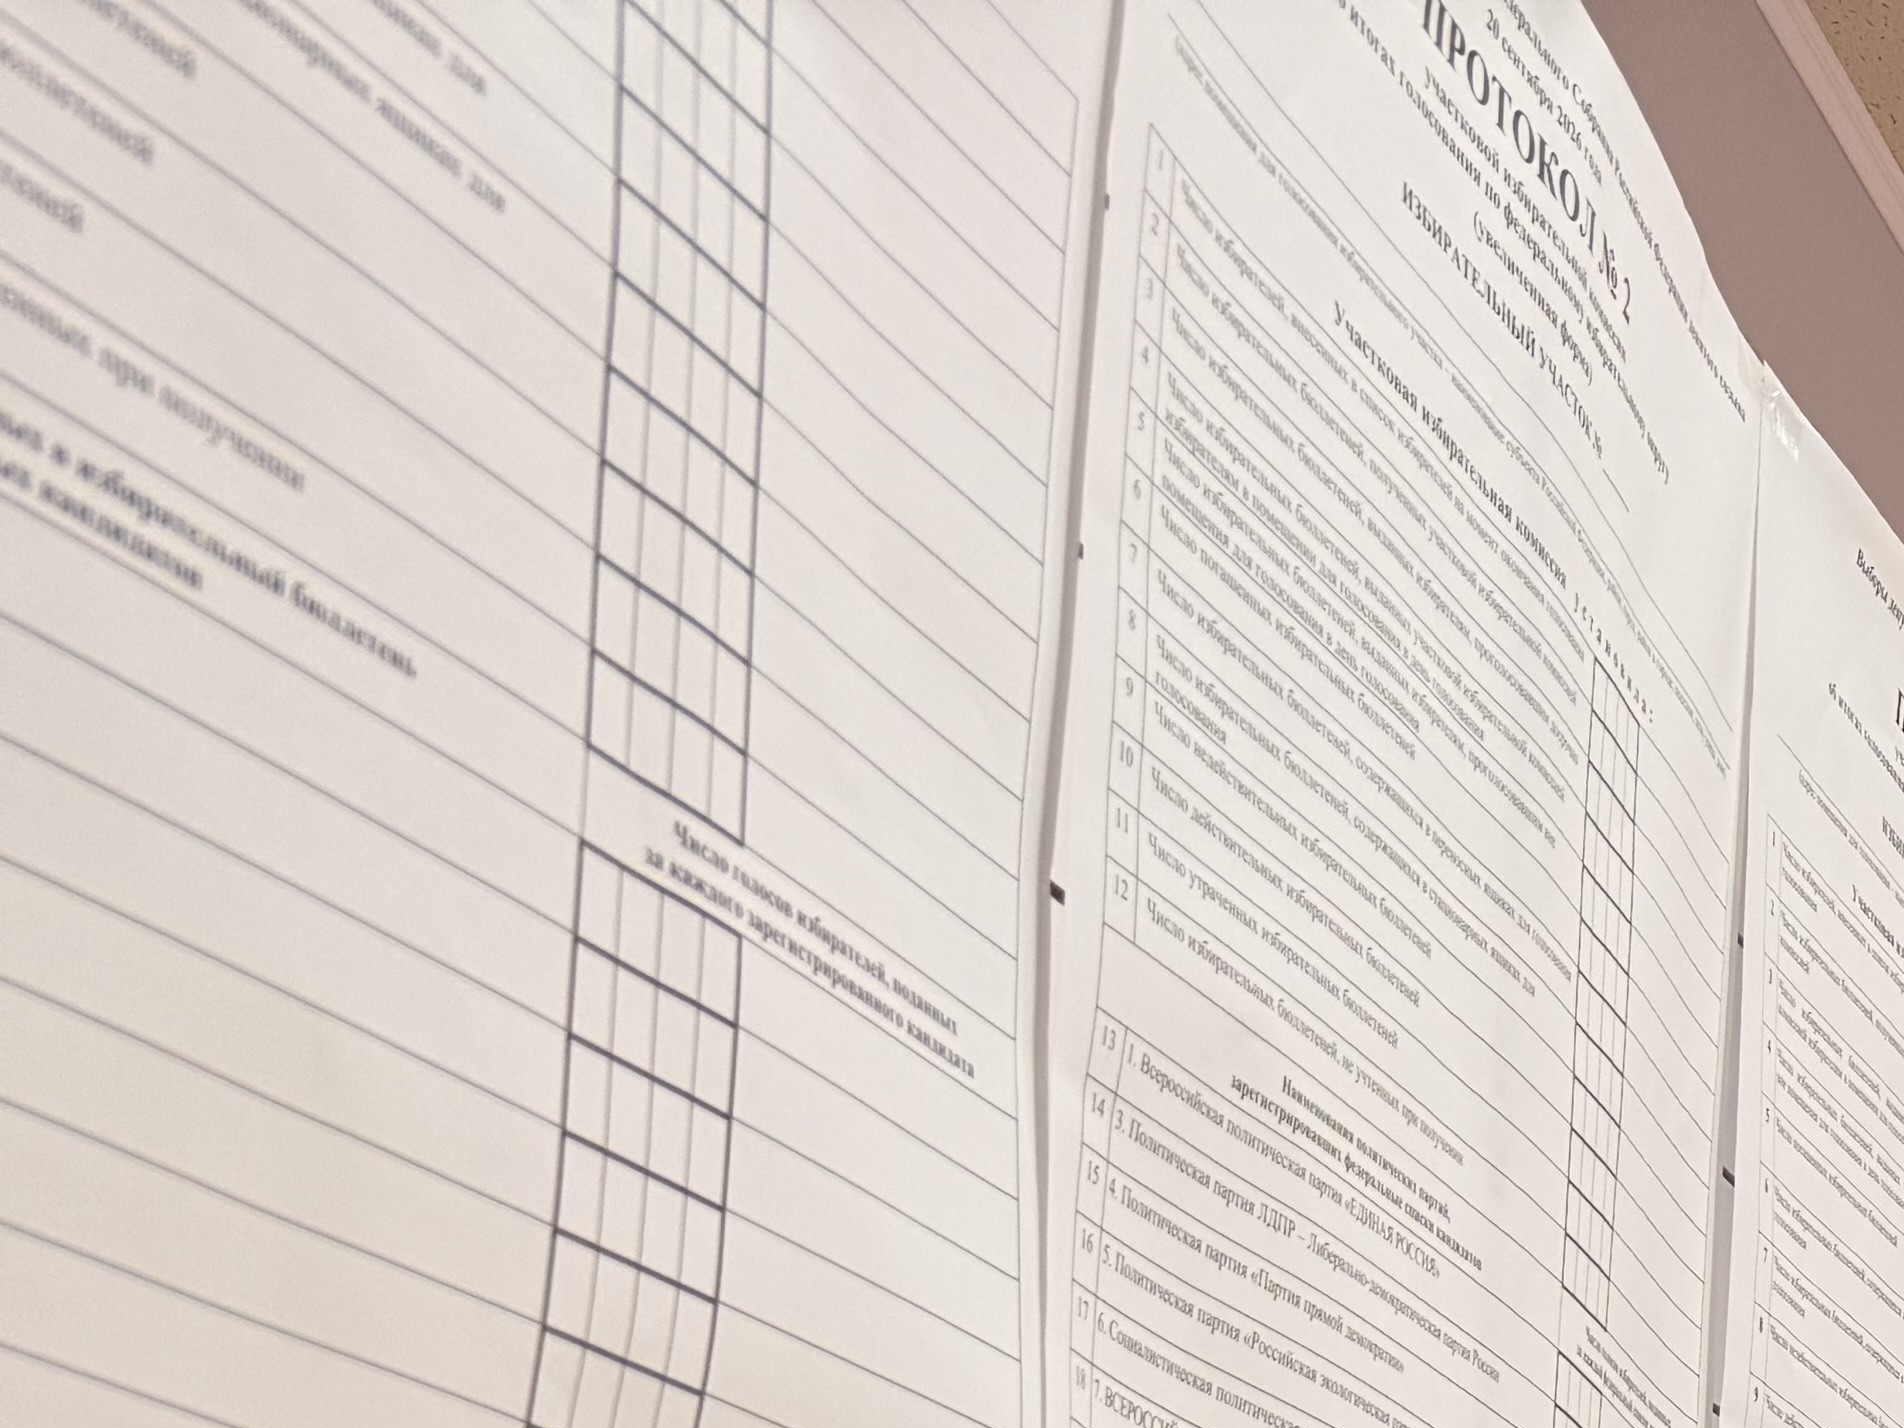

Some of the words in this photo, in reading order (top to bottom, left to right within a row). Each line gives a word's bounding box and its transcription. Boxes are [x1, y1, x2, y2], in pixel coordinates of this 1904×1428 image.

[1421, 0, 1596, 254] ПРОТОКОЛ
[1599, 231, 1618, 299] №
[1622, 277, 1631, 325] 2
[1424, 66, 1500, 173] участковой
[1503, 164, 1588, 291] избирательной
[1502, 34, 1554, 115] сентября
[1556, 105, 1582, 148] 2026
[1401, 182, 1536, 359] ИЗБИРАТЕЛЬНЫЙ
[1538, 348, 1592, 441] УЧАСТОК
[1334, 300, 1419, 413] Участковая
[1421, 404, 1513, 522] избирательная
[1515, 515, 1568, 590] комиссия
[645, 846, 664, 870] за
[670, 862, 744, 920] каждого
[748, 908, 903, 1028] зарегистрированного
[907, 1016, 975, 1078] кандидата
[674, 820, 729, 874] Число
[733, 866, 794, 919] голосов
[893, 980, 958, 1036] поданных
[1091, 1091, 1106, 1118] 14
[1101, 1025, 1117, 1051] 13
[1127, 1043, 1137, 1068] 1.
[1141, 1052, 1225, 1129] Всероссийская
[1226, 1119, 1307, 1181] политическая
[1308, 1168, 1344, 1209] партия
[1344, 1196, 1394, 1242] «ЕДИНАЯ
[1128, 1117, 1211, 1190] Политическая
[1213, 1180, 1256, 1217] партия
[1257, 1202, 1296, 1239] ЛДПР
[1121, 1183, 1202, 1254] Политическая
[1204, 1243, 1248, 1279] партия
[1250, 1268, 1300, 1309] «Партия
[1303, 1300, 1344, 1336] прямой
[1197, 1306, 1241, 1343] партия
[1243, 1330, 1318, 1383] «Российская
[1109, 1319, 1212, 1396] Социалистическая
